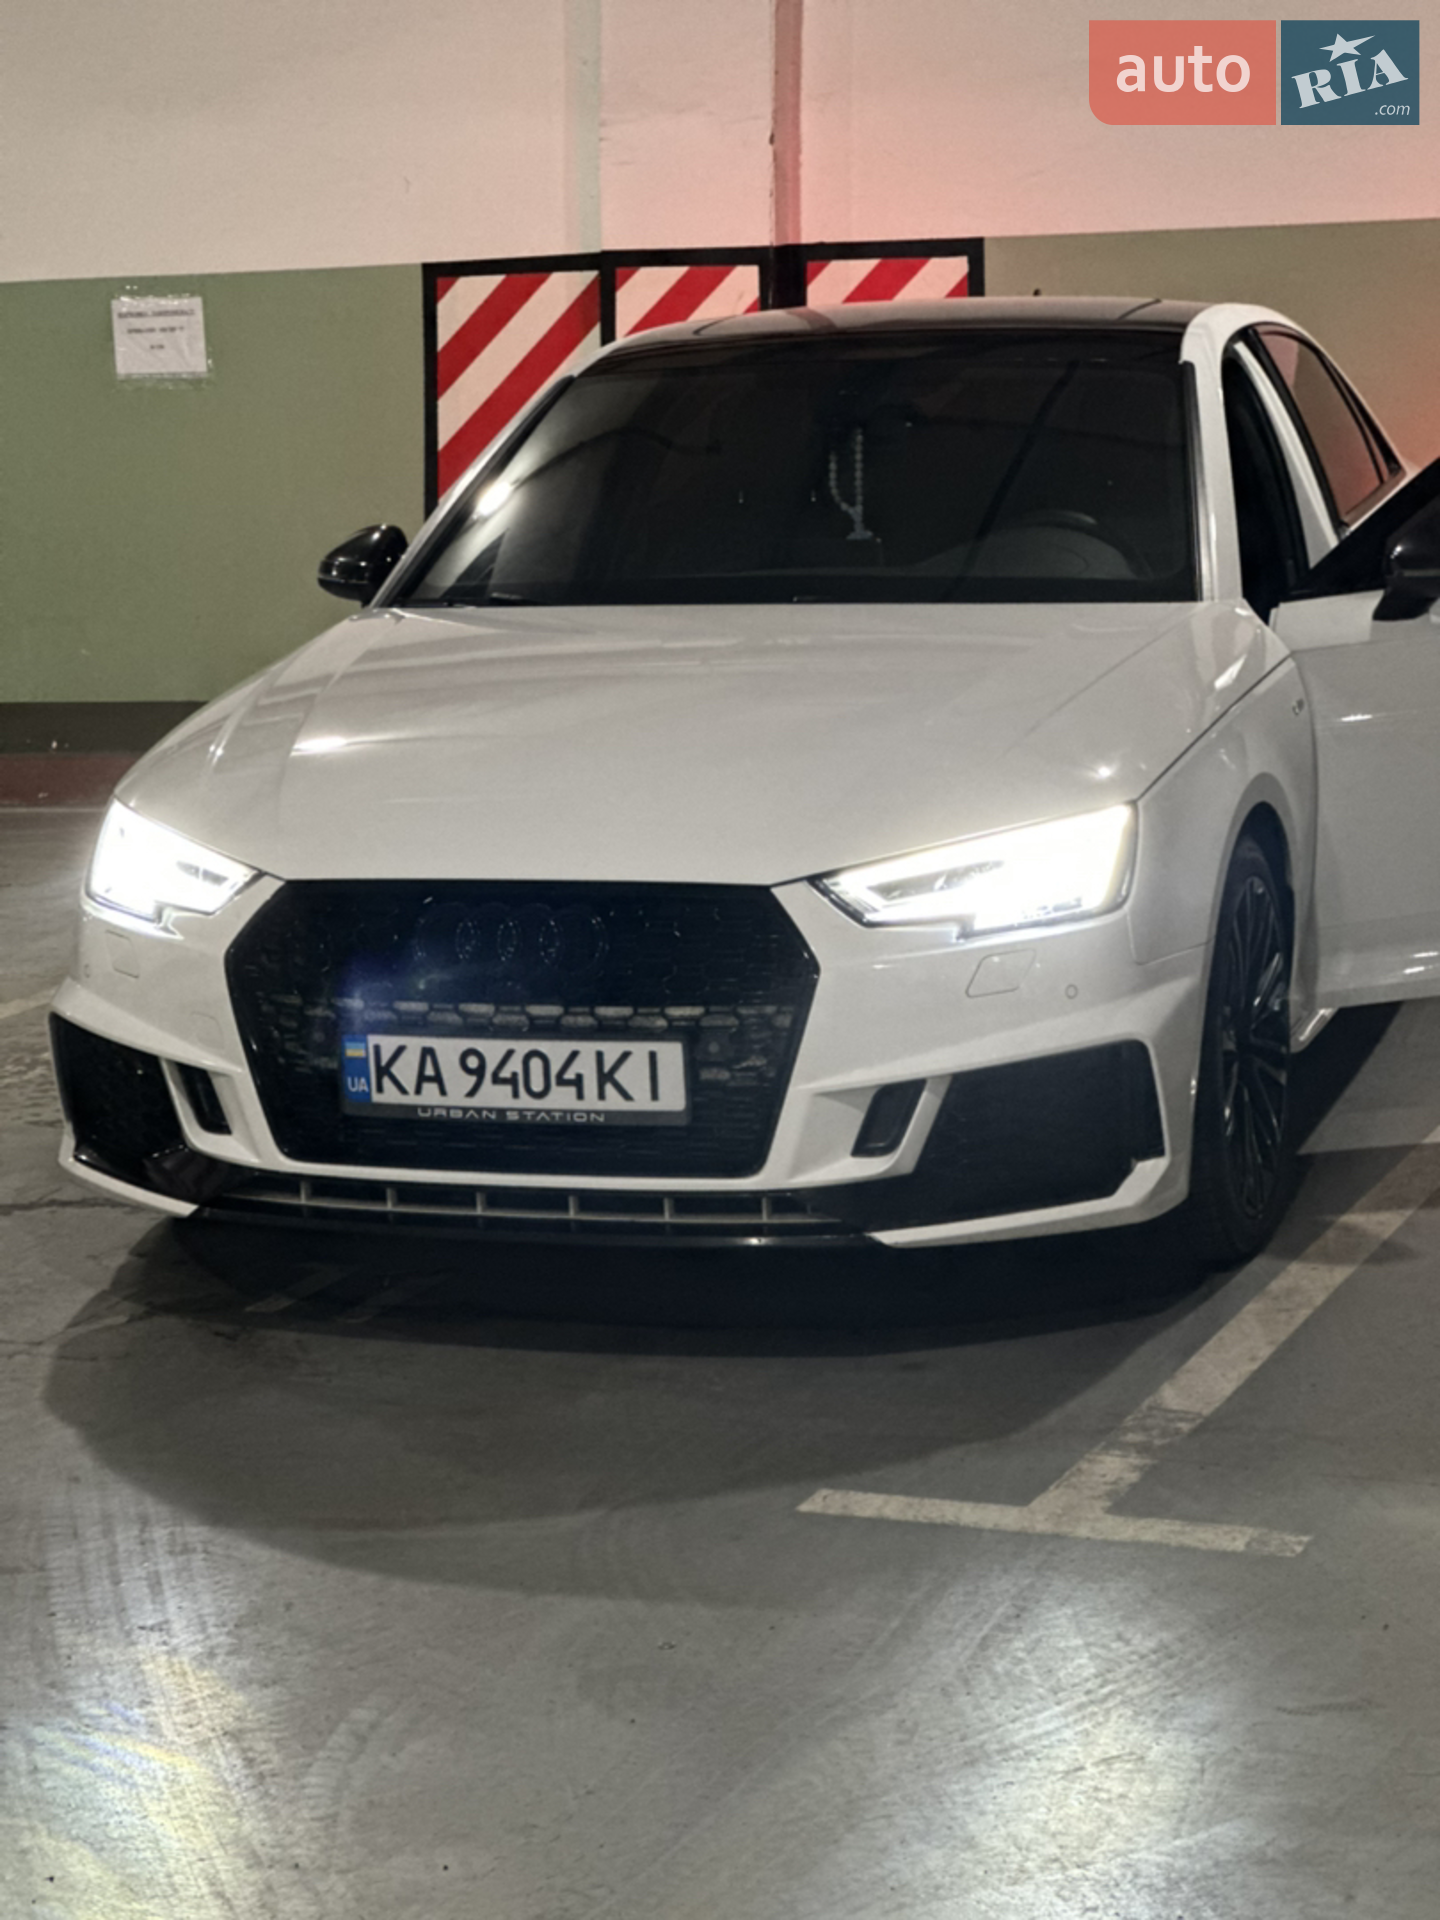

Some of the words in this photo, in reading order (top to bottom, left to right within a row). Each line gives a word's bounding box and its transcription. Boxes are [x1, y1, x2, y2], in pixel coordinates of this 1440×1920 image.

[372, 1043, 449, 1097] KA
[458, 1047, 585, 1101] 9404
[594, 1049, 660, 1102] KI
[347, 1076, 369, 1093] UA
[417, 1107, 497, 1120] URBAN
[506, 1110, 605, 1123] STATION
